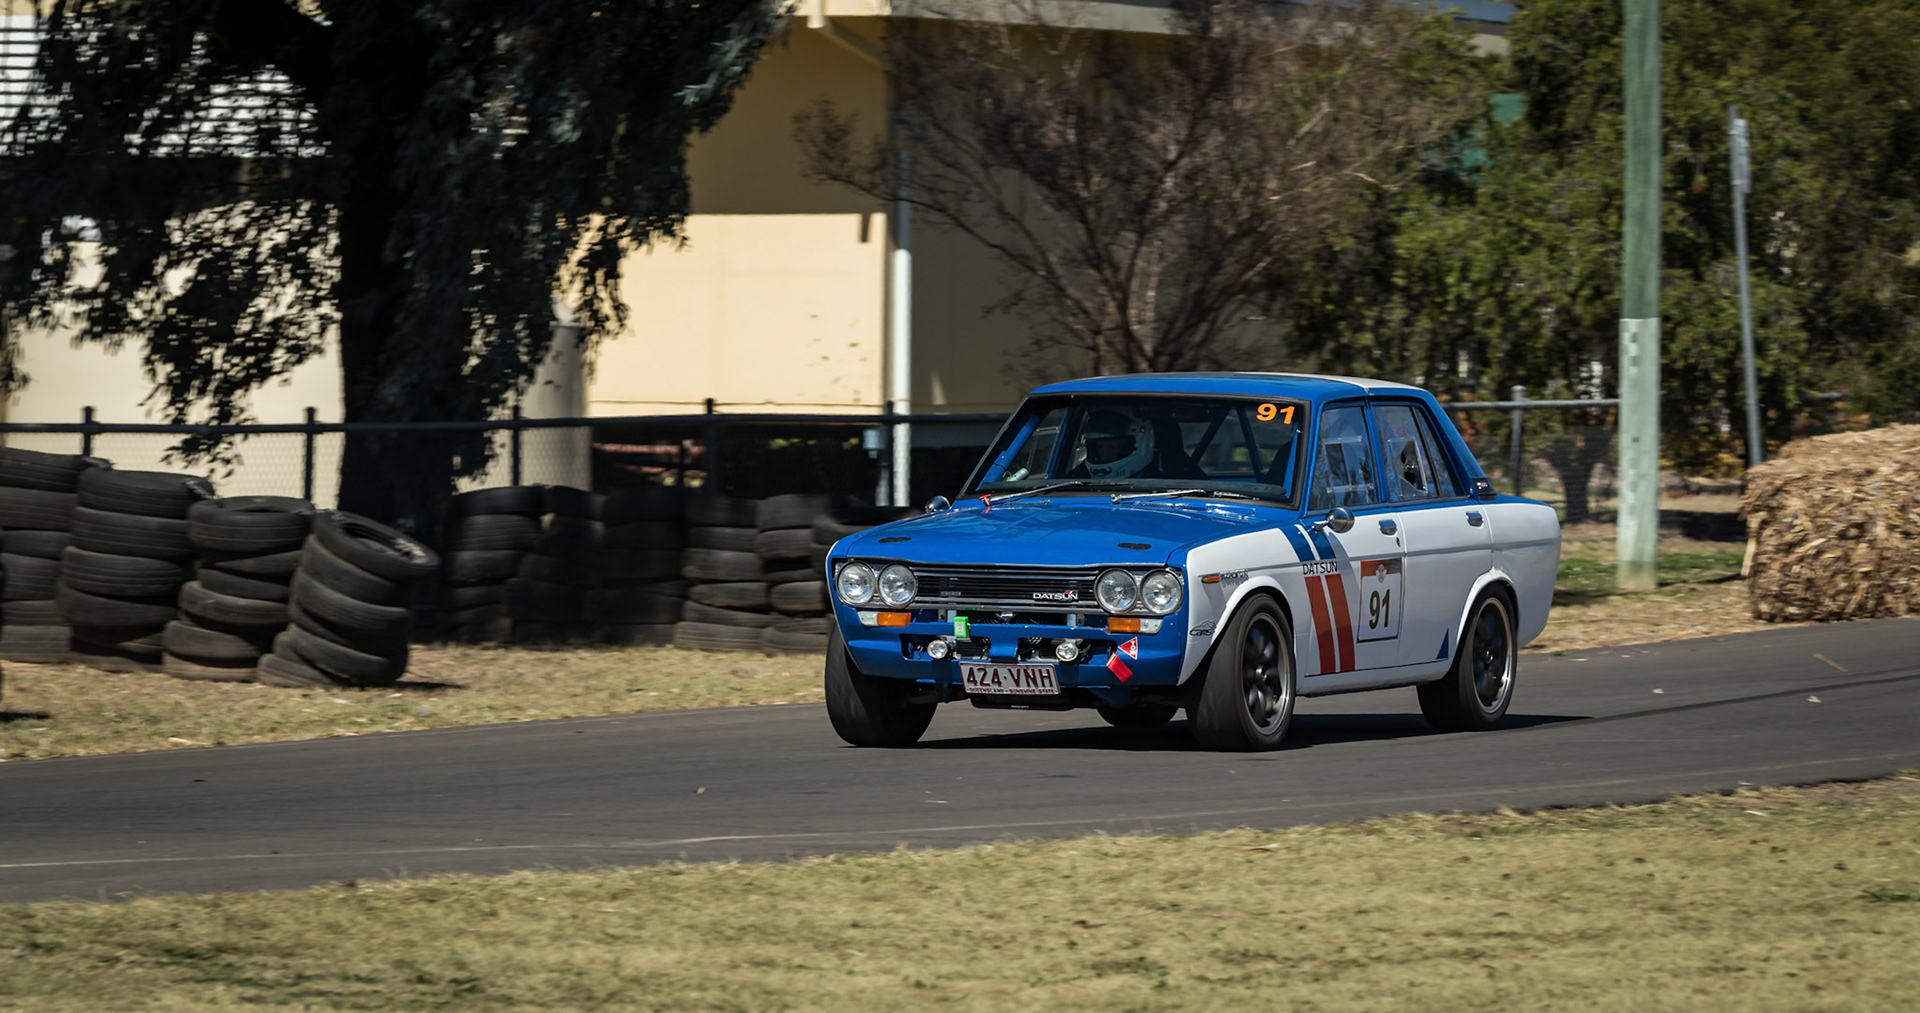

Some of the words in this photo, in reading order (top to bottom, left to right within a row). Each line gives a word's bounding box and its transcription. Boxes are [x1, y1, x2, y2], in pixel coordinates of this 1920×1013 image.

[1256, 403, 1295, 425] 91
[1303, 561, 1338, 575] DATSUN
[1032, 591, 1079, 600] DATSUN
[1369, 589, 1390, 629] 91
